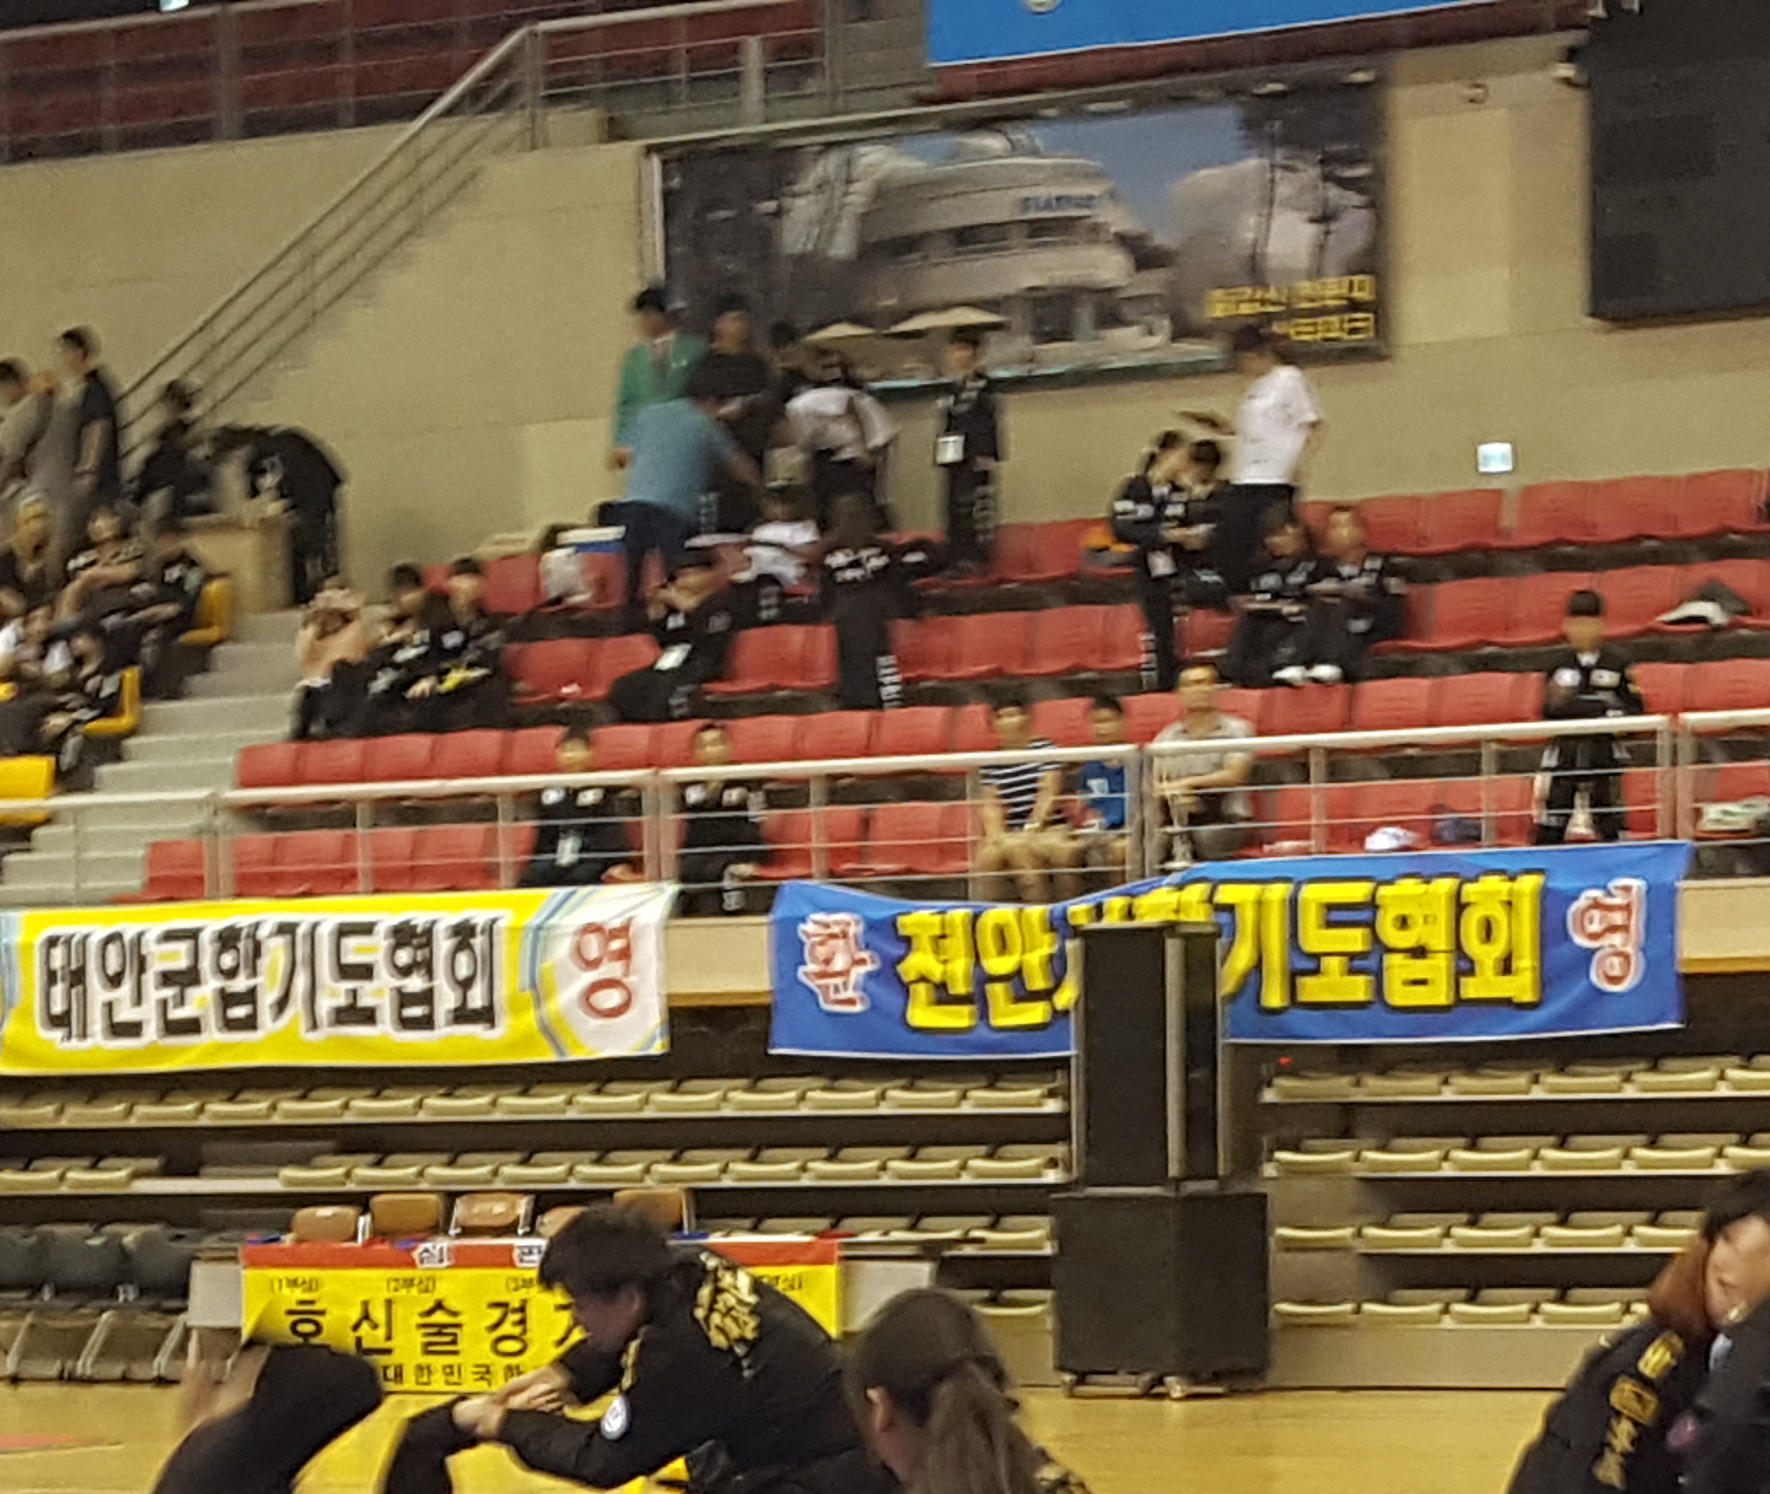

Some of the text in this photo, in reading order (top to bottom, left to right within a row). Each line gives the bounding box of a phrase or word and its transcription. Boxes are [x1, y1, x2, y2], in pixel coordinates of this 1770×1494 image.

[40, 916, 502, 1042] 태안군합기도협회
[570, 921, 633, 1019] 영
[798, 873, 1645, 1029] 환 천안기도협회 영
